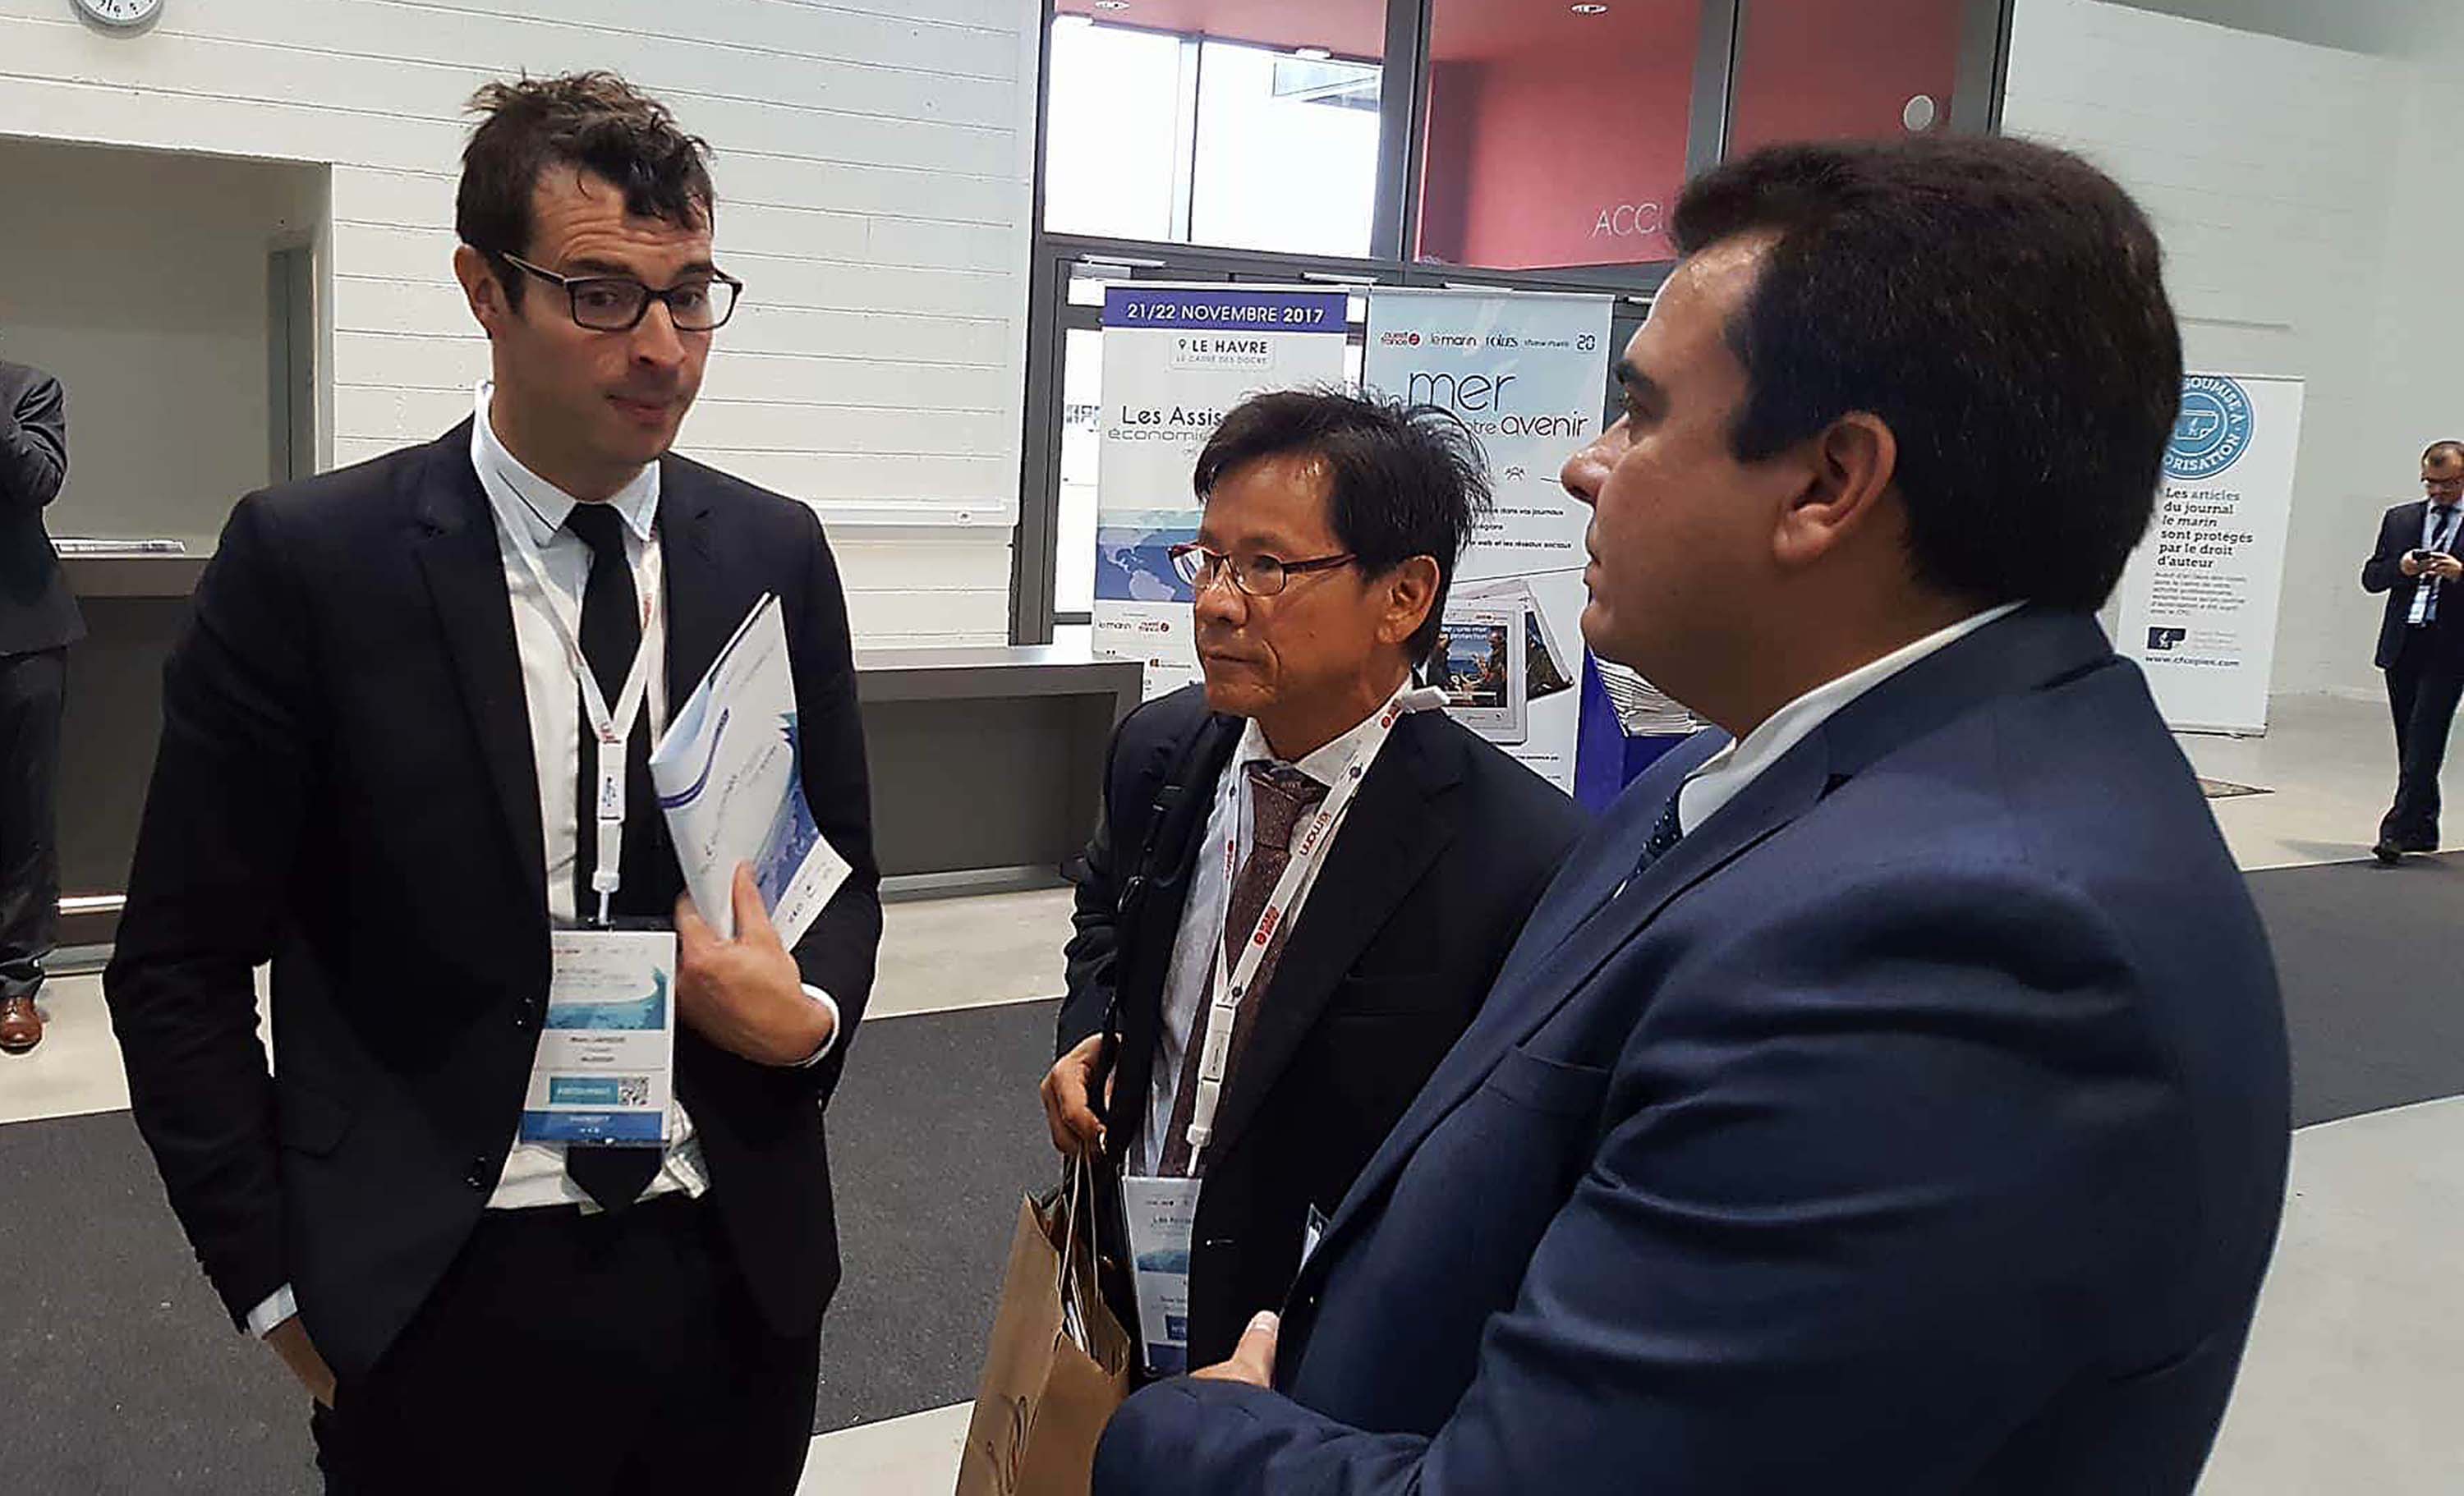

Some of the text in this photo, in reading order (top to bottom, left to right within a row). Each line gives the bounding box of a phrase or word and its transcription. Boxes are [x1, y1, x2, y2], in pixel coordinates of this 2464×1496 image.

[1128, 303, 1325, 324] 21/22 NOVEMBRE 2017
[1193, 340, 1268, 354] LE HAVRE
[1576, 334, 1596, 351] 20
[1408, 372, 1517, 411] mer
[1122, 405, 1161, 425] Les
[1168, 406, 1223, 426] Assis
[1501, 411, 1589, 438] avenir
[2163, 432, 2242, 471] ORISATION
[2165, 487, 2241, 502] Les articles
[2163, 501, 2234, 516] du journal
[2163, 514, 2218, 527] le marin
[2160, 530, 2191, 541] sont
[2158, 543, 2233, 557] par le droit
[2157, 555, 2215, 568] d'auteur
